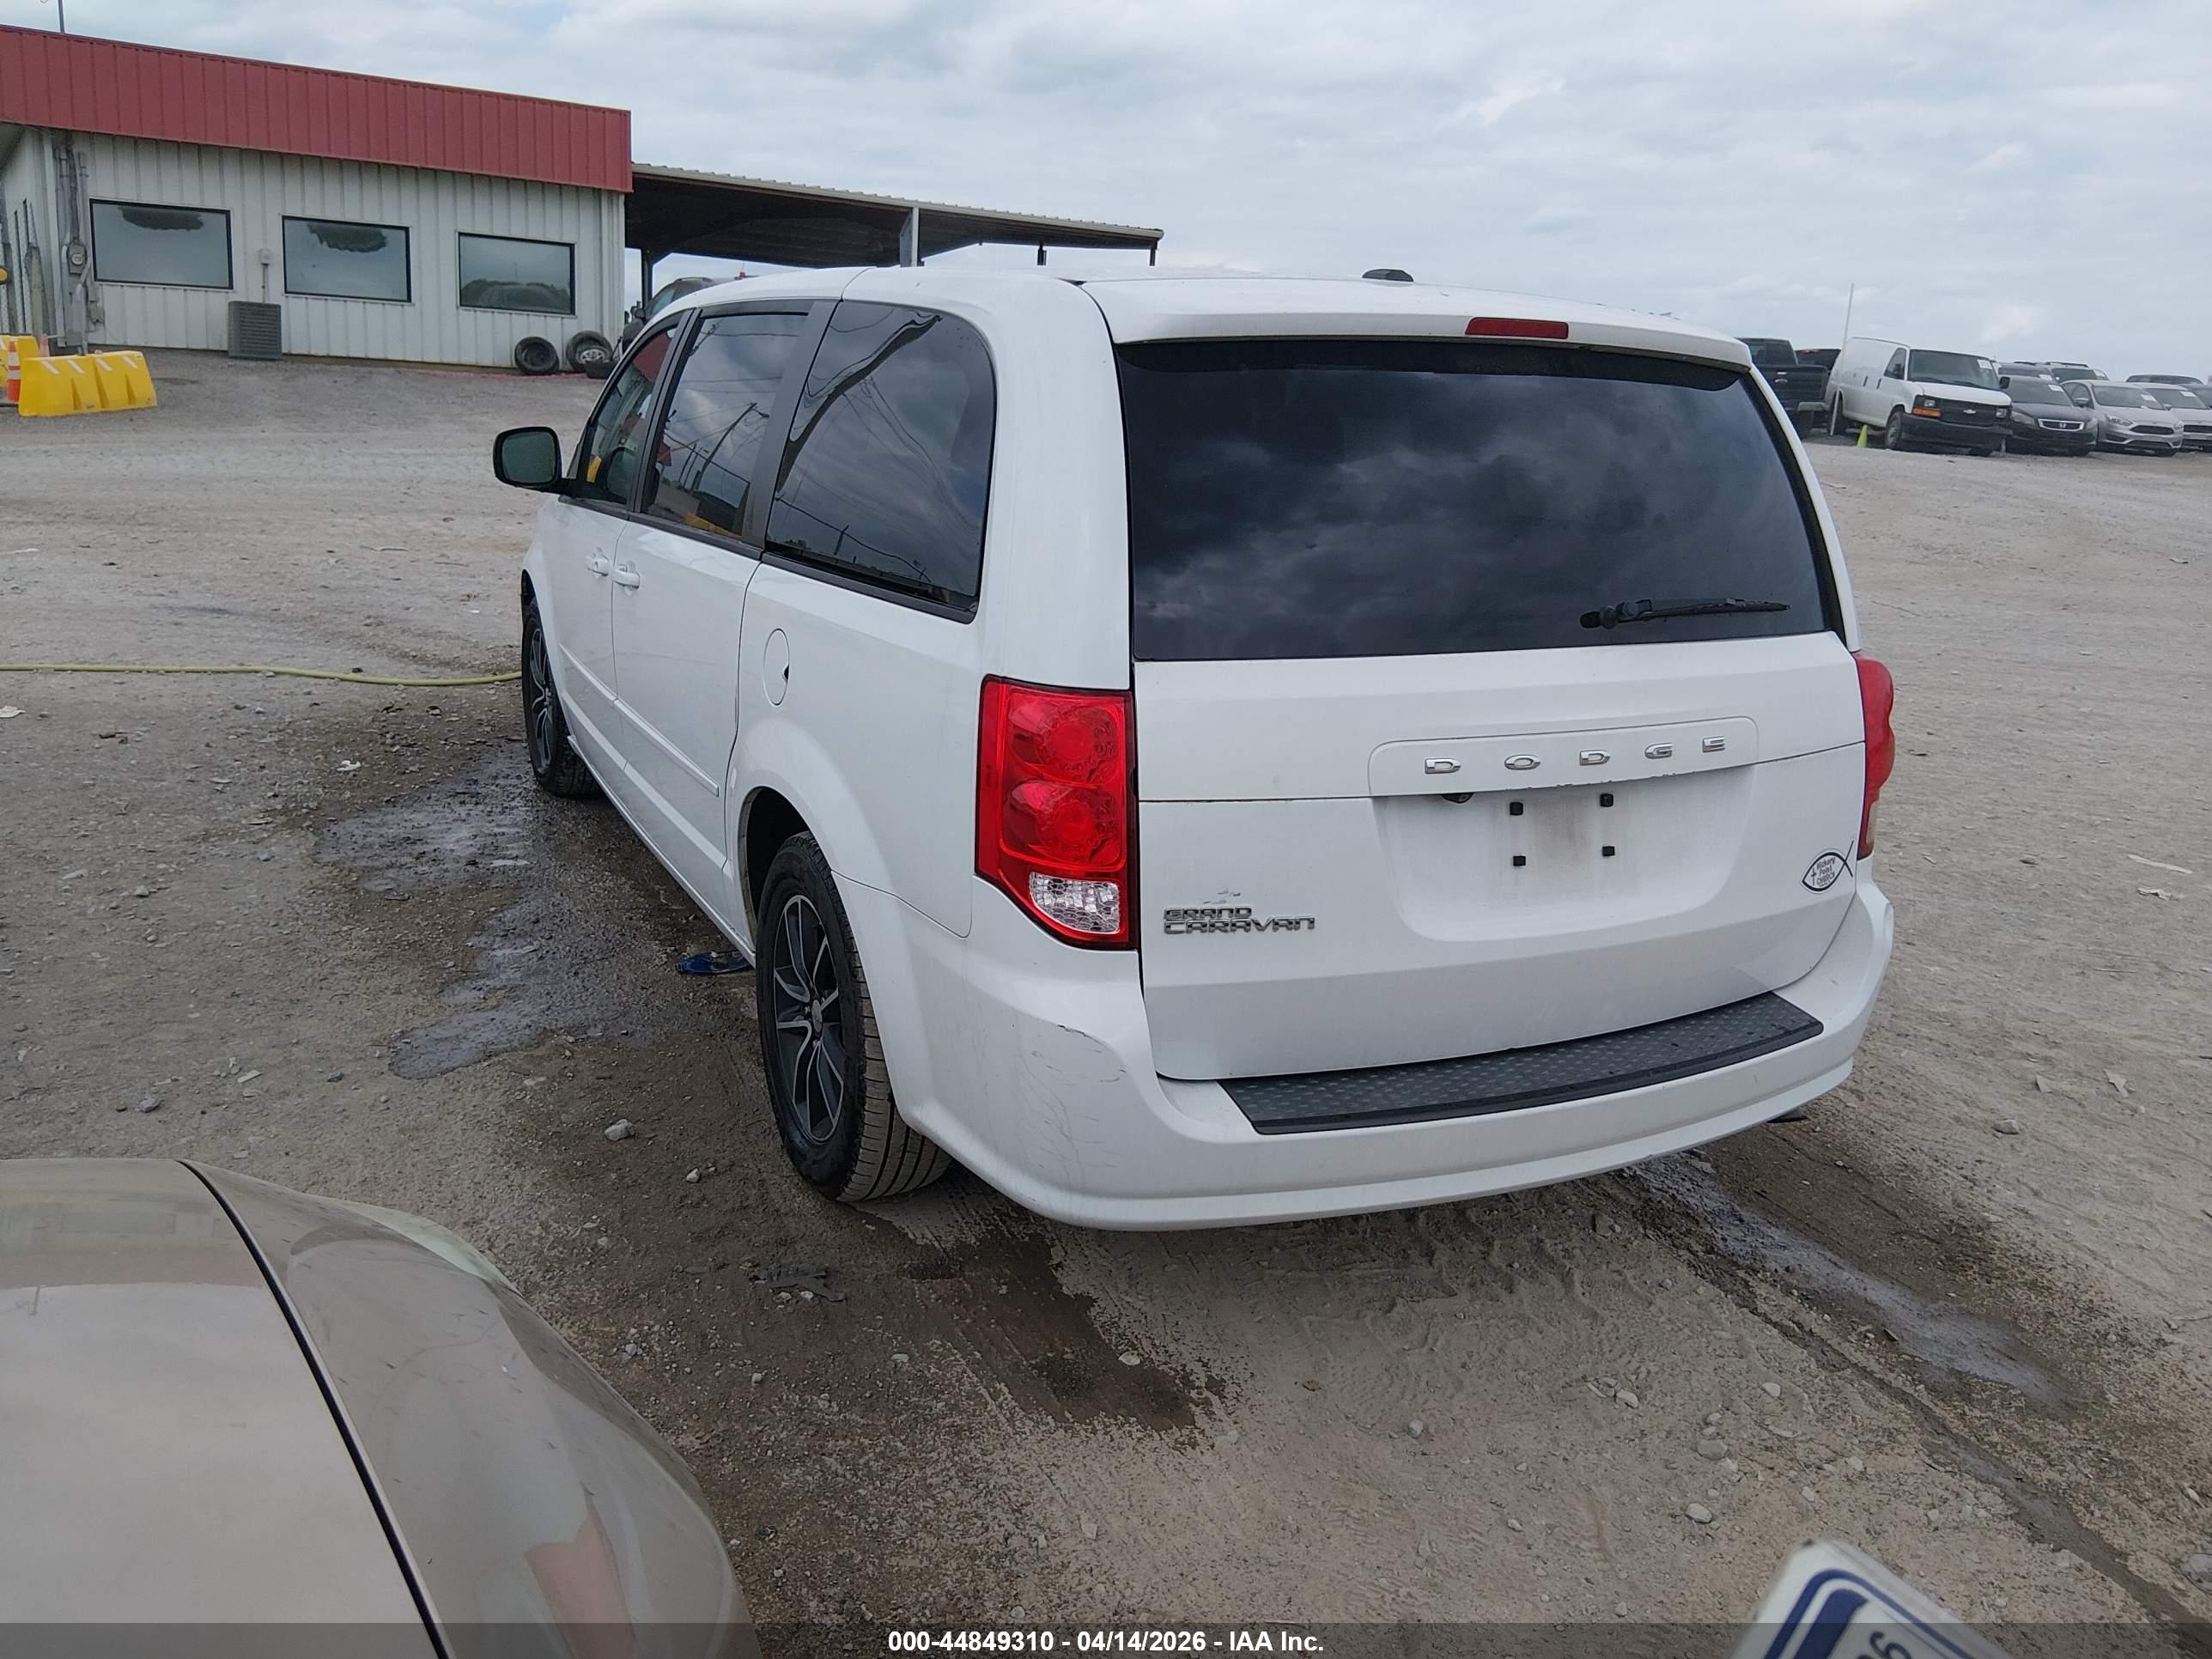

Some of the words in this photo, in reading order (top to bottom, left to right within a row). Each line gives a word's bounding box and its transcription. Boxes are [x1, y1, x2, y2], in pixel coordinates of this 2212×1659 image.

[1425, 736, 1726, 775] DODGE
[1164, 907, 1252, 921] GRAND
[1164, 917, 1316, 935] CARAVAN
